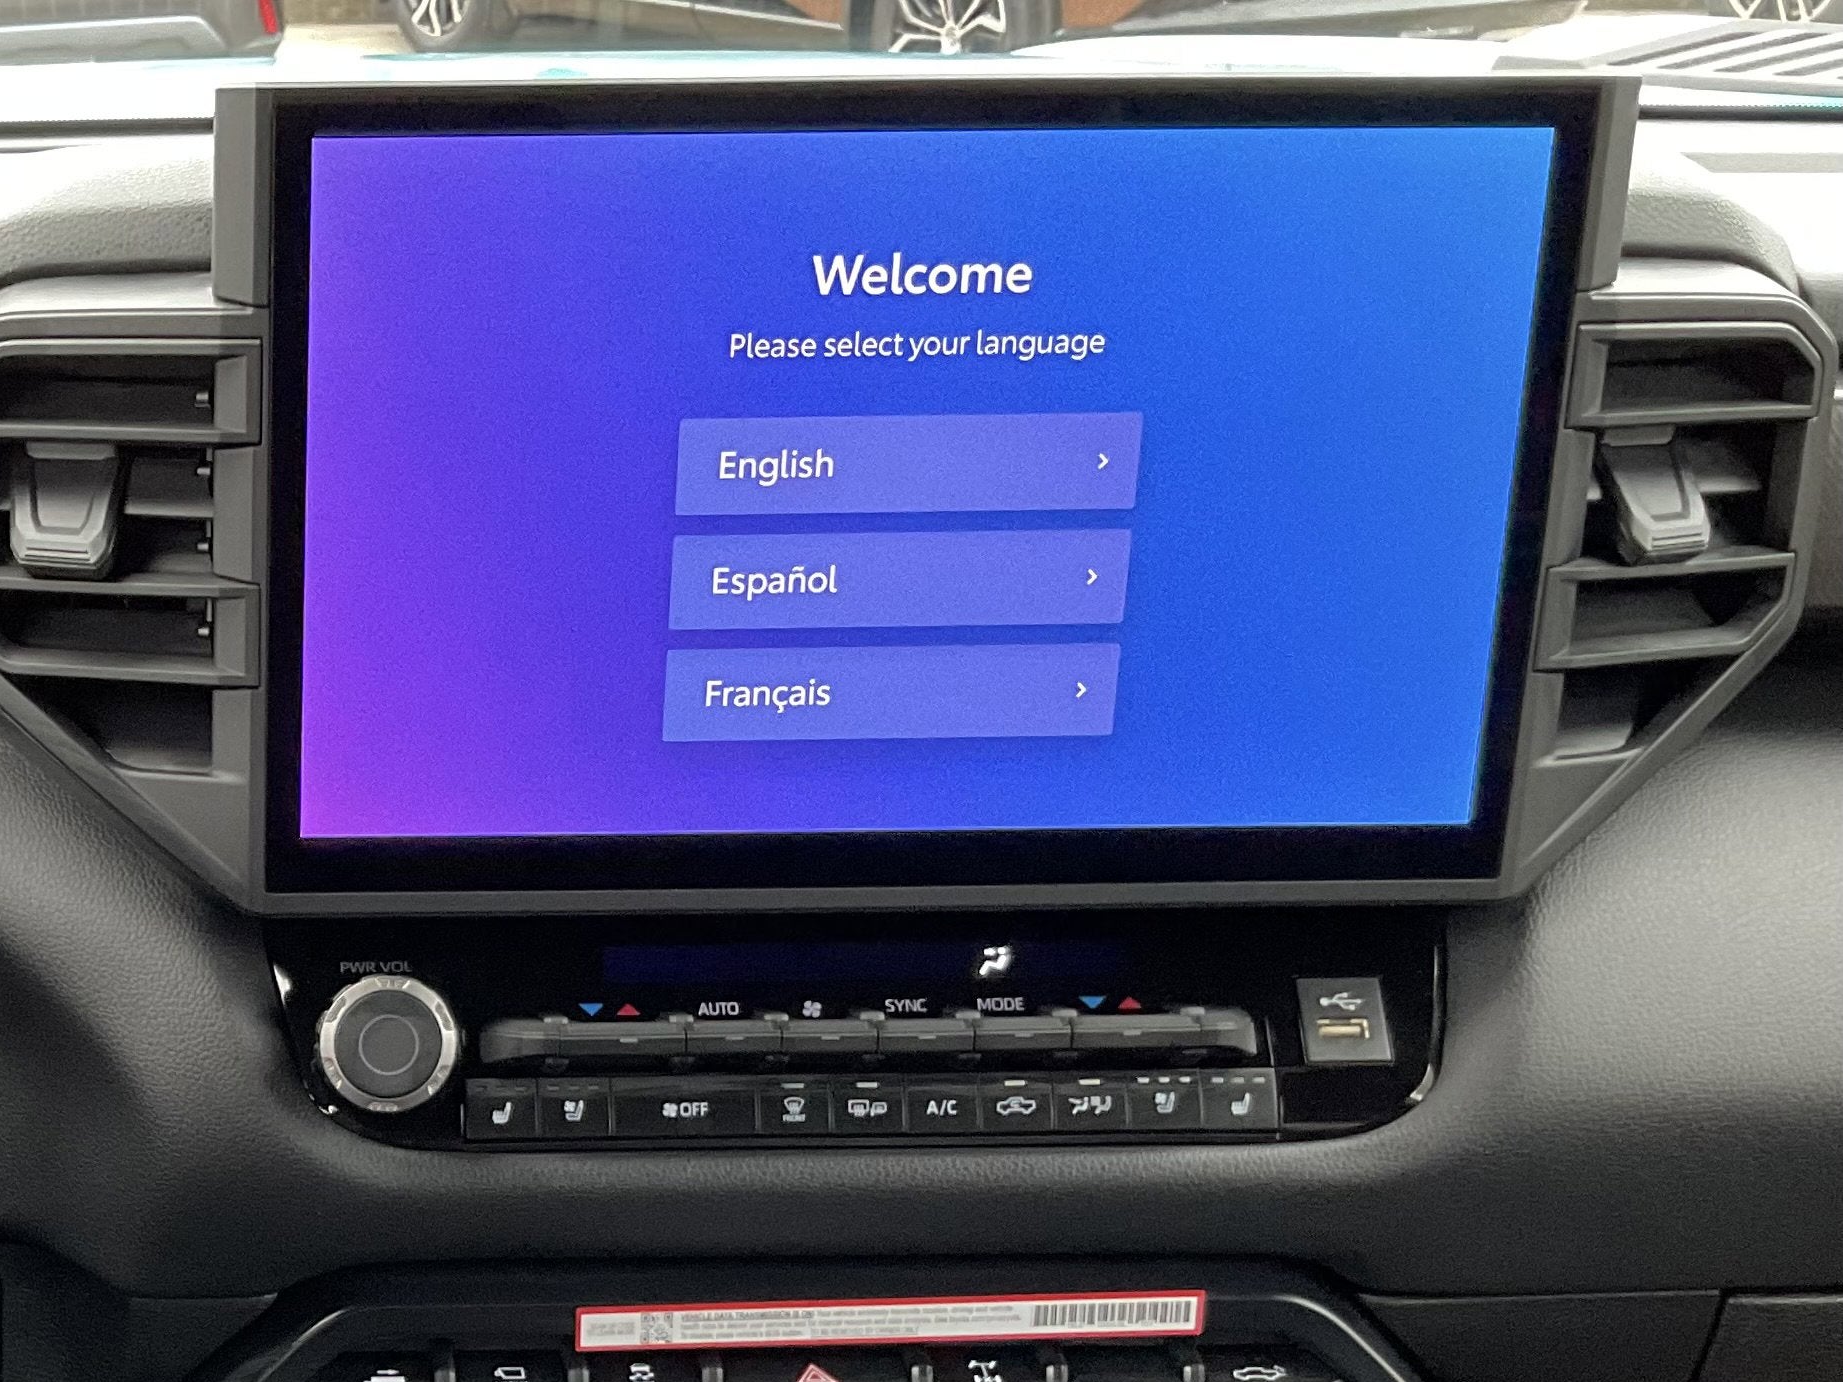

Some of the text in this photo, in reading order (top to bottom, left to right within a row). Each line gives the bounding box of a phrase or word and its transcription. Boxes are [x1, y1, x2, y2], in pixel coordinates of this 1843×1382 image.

[812, 252, 1033, 296] Welcome
[729, 329, 1106, 361] Please select your language
[718, 448, 835, 486] English
[712, 565, 837, 601] Español
[705, 679, 831, 713] Français
[340, 961, 412, 974] PWR VOL
[698, 1002, 740, 1018] AUTO
[884, 998, 927, 1013] SYNC
[976, 997, 1026, 1012] MODE
[680, 1102, 709, 1117] OFF
[926, 1101, 957, 1117] A/C
